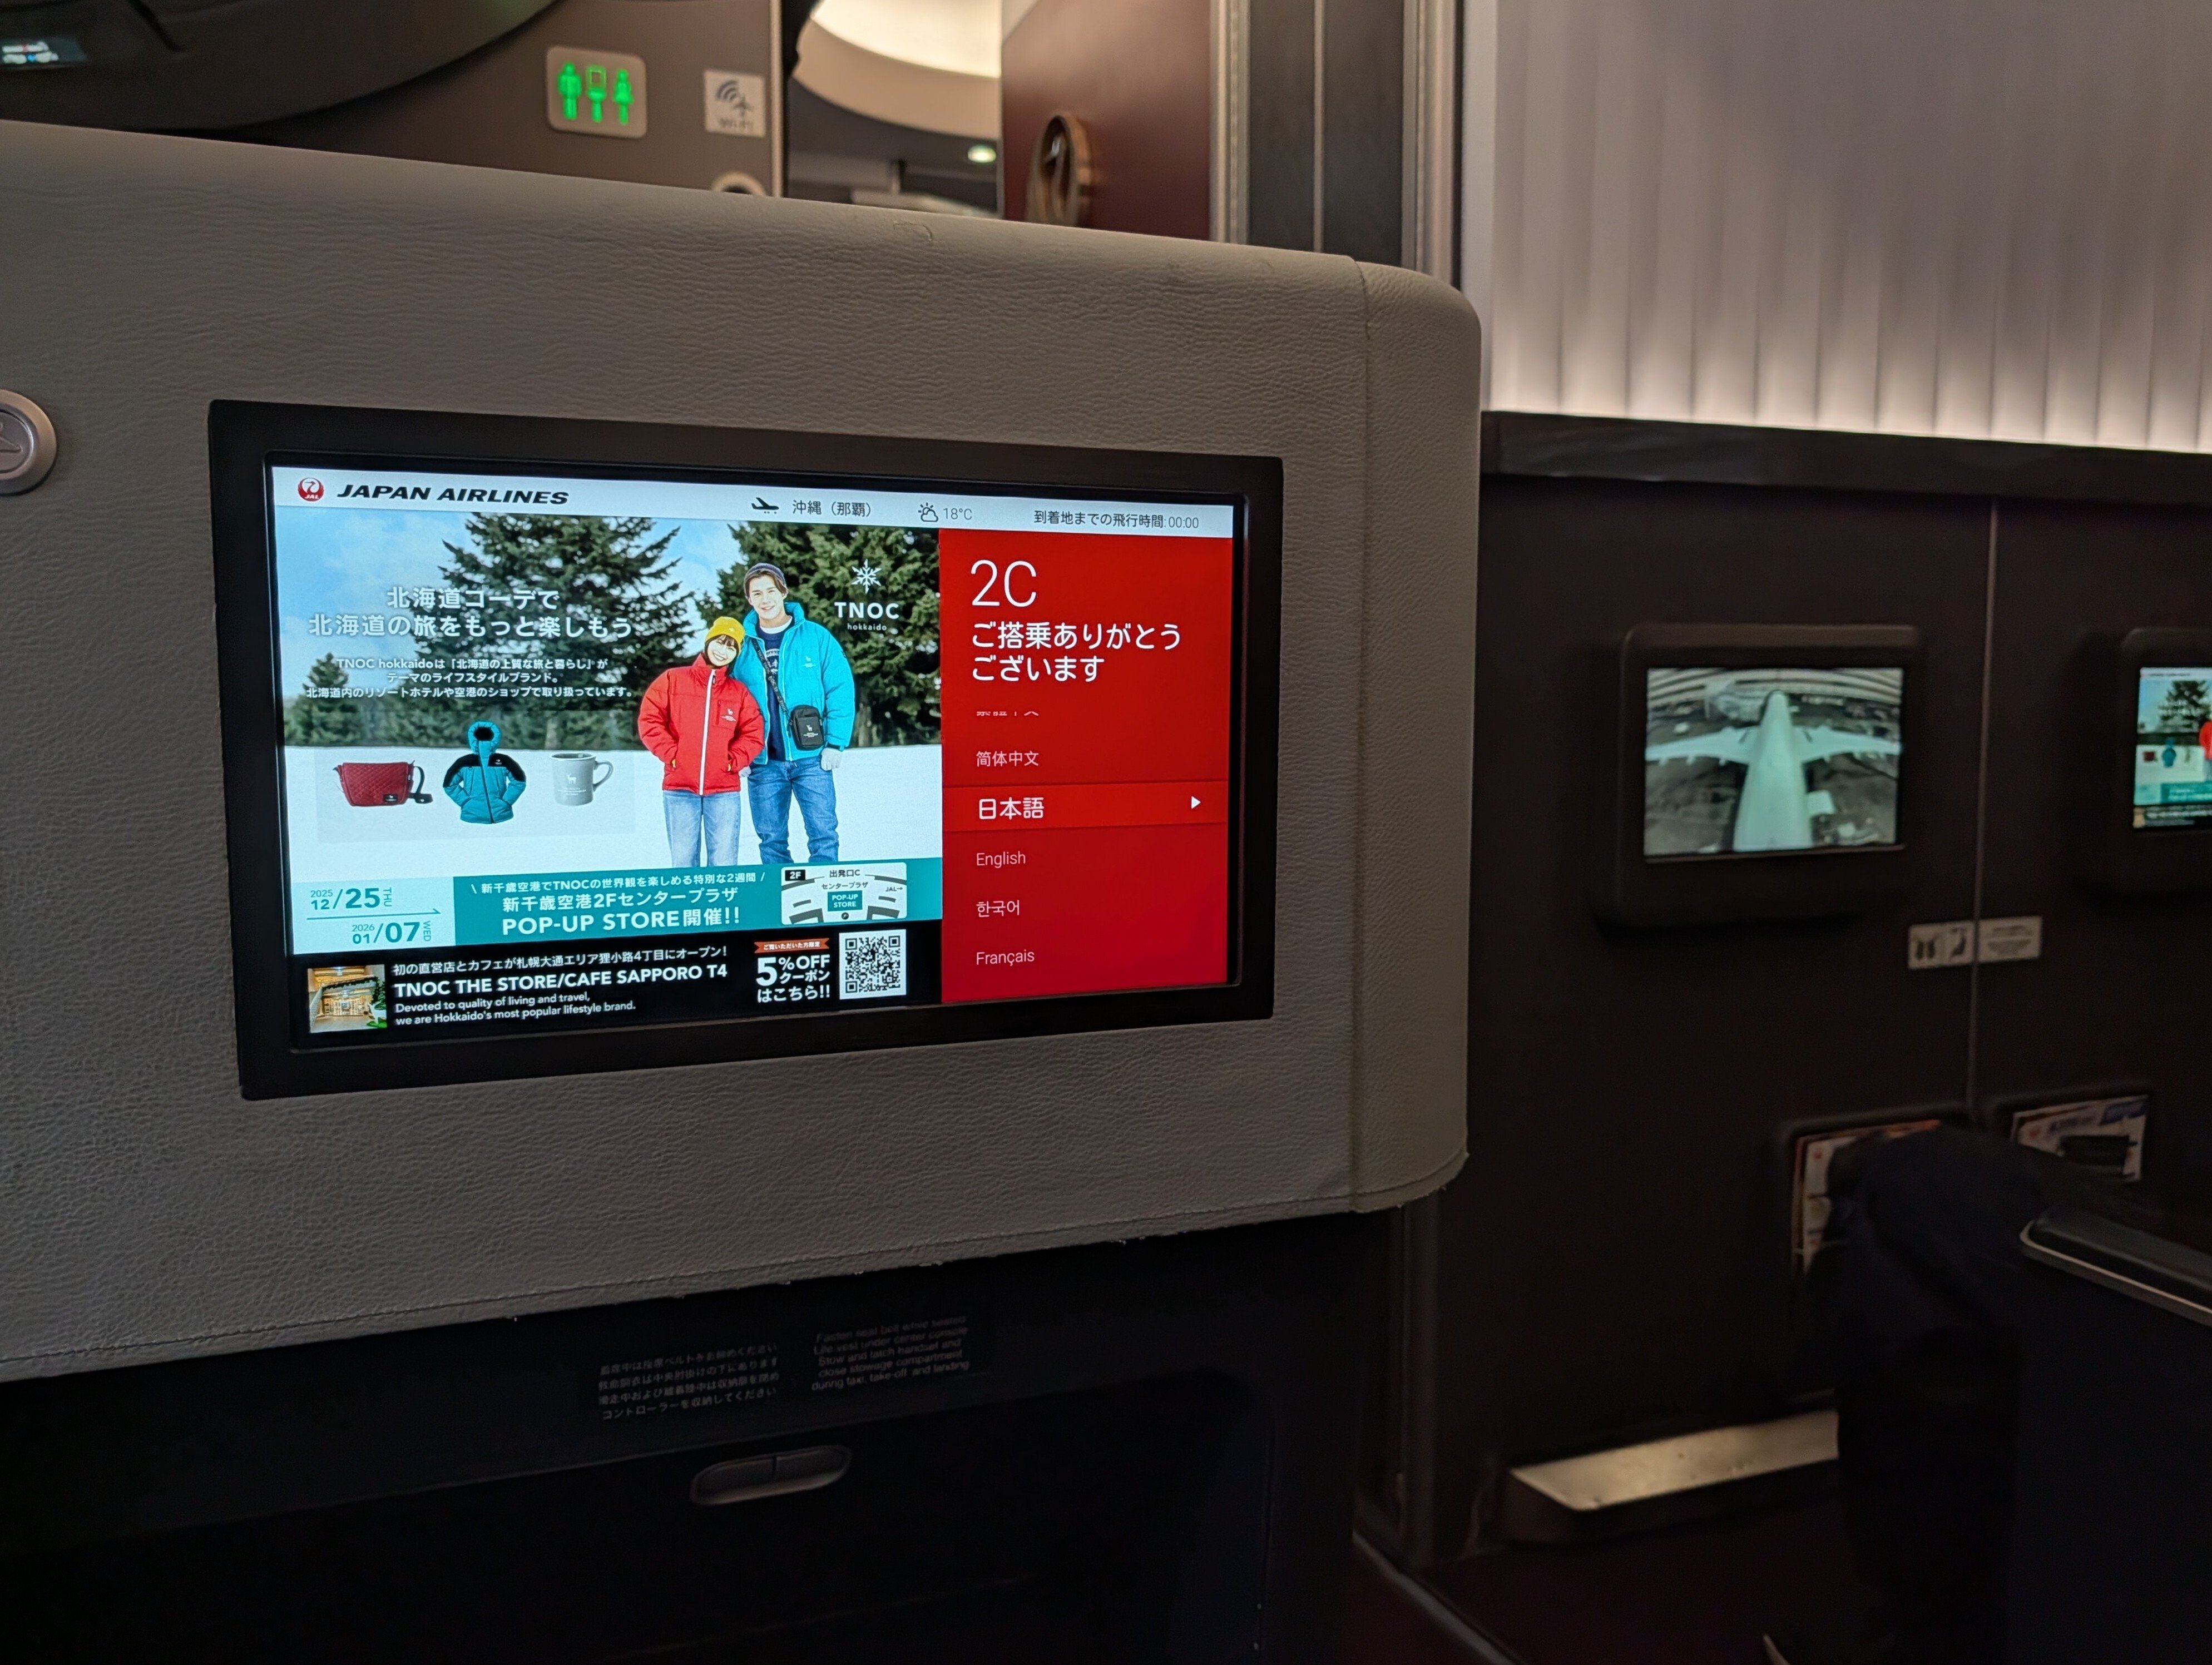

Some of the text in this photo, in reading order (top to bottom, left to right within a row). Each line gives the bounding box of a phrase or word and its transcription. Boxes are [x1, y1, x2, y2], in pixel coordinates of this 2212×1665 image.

[337, 484, 569, 504] JAPAN AIRLINES
[943, 507, 973, 521] 18°C
[1169, 517, 1199, 529] 00:00
[971, 559, 1037, 607] 2C
[387, 586, 560, 611] 北海道コーデで
[834, 601, 899, 619] TNOC
[309, 614, 631, 638] 北海道の旅をもっと楽しもう
[847, 622, 887, 631] hokkaido
[973, 621, 1180, 650] ご搭乗ありがとう
[336, 658, 374, 668] TNOC
[973, 655, 1105, 682] ございます
[387, 672, 558, 684] テーマのライフスタイルブランド。
[306, 686, 632, 698] 北海道内のリゾートホテルや空港のショップで取り扱っています。
[976, 751, 1039, 767] 简体中文
[979, 797, 1045, 820] 日本語
[976, 851, 1026, 868] English
[790, 871, 801, 880] 2F
[829, 869, 860, 878] 出発口C
[310, 889, 333, 898] 2025
[822, 881, 869, 890] センタープラザ
[384, 887, 392, 907] THU
[503, 886, 738, 912] 新千歳空港2Fセンタープラザ
[976, 900, 1020, 918] 한국어
[503, 914, 595, 935] POP-UP
[764, 941, 820, 950] ご覧いただいた方限定
[976, 949, 1035, 967] Français
[394, 964, 728, 998] TNOC THE STORE/CAFE SAPPORO T4
[779, 969, 830, 984] クーポン
[395, 992, 590, 1013] Devoted to quality of living and travel,
[758, 984, 830, 1003] はこちら!!
[434, 1010, 492, 1023] Hokkaido's
[494, 1009, 520, 1019] most
[522, 1006, 562, 1021] popular
[563, 1003, 602, 1017] lifestyle
[604, 1001, 635, 1011] brand.
[811, 1377, 844, 1391] during
[912, 1365, 931, 1376] and
